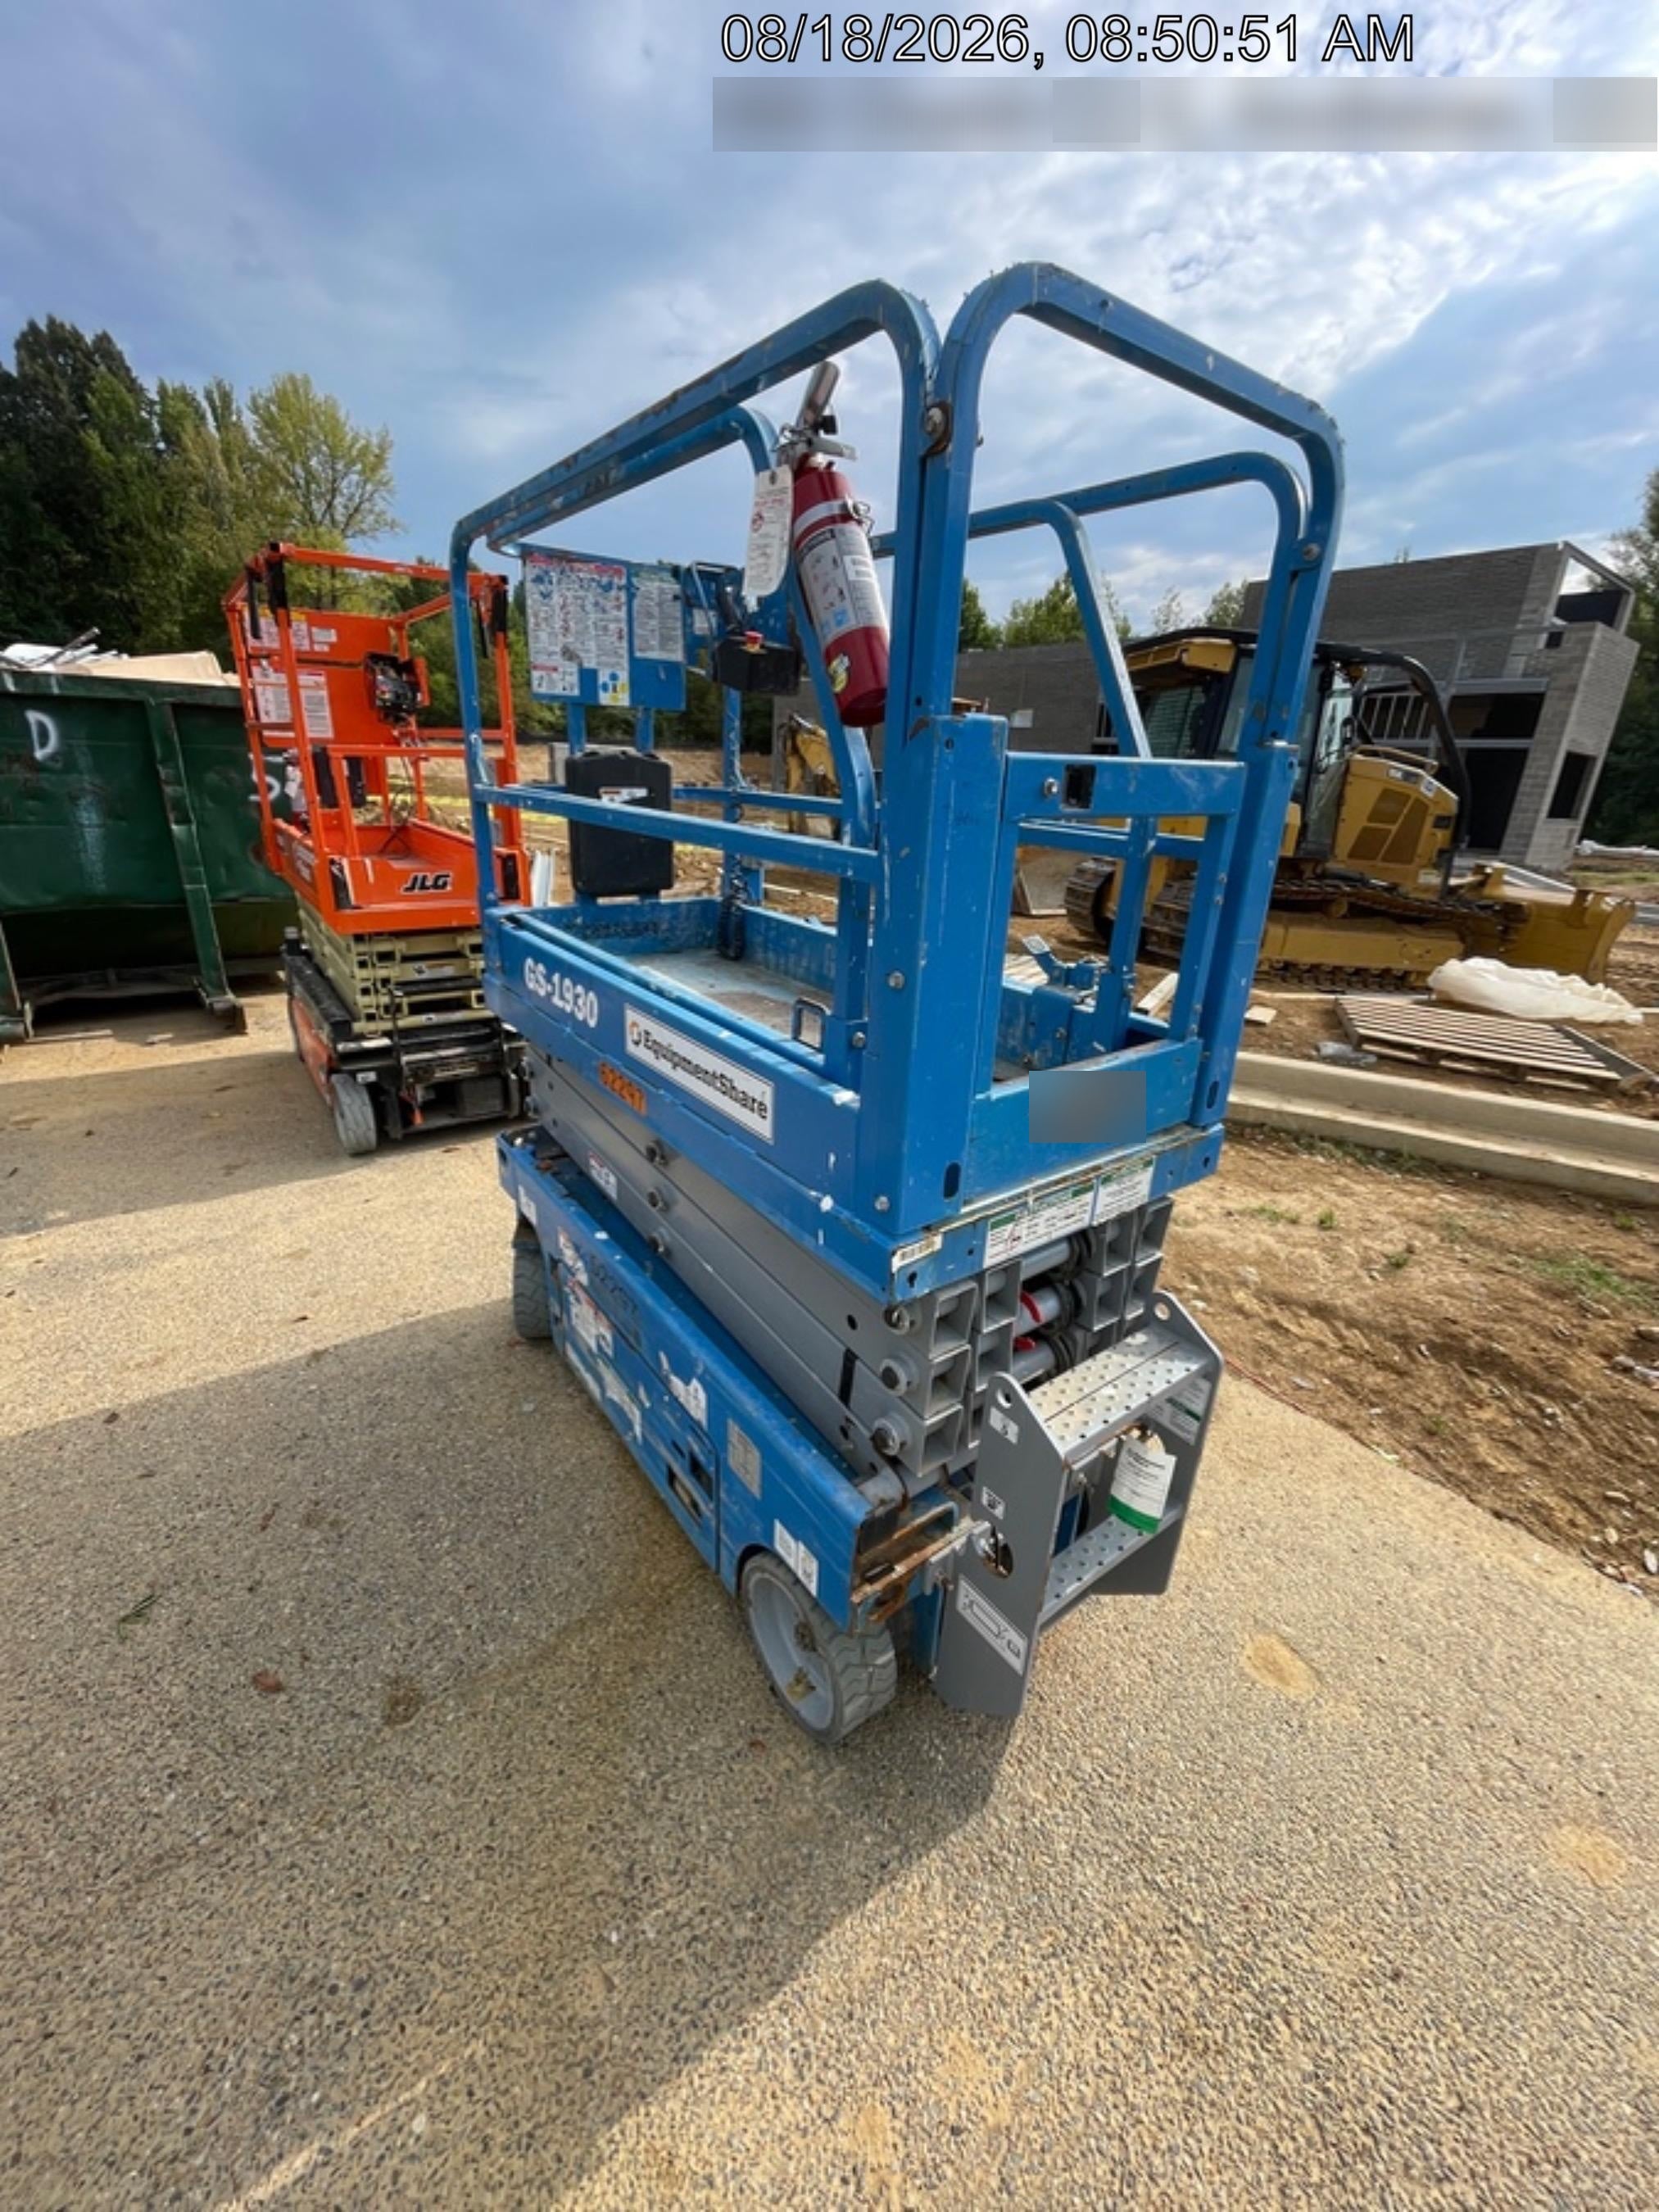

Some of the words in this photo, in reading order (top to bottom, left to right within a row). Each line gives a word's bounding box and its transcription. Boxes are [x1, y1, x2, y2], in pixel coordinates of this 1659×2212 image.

[24, 709, 58, 761] D
[402, 873, 451, 893] JLG
[524, 957, 598, 1028] GS-1930
[643, 1028, 768, 1120] EquipmentShare
